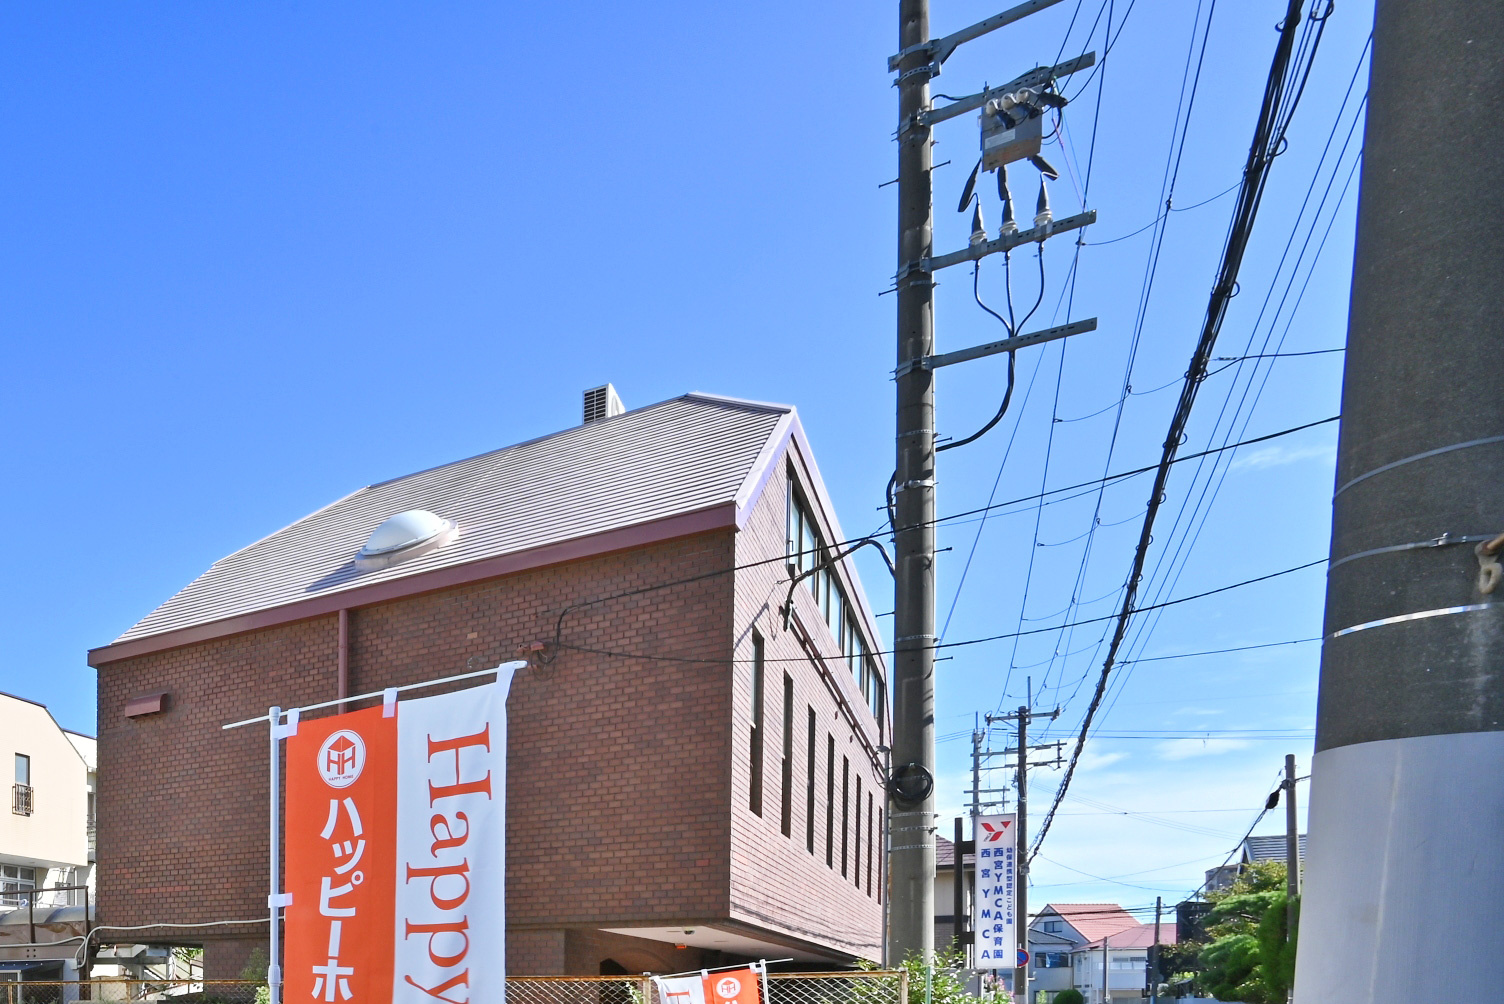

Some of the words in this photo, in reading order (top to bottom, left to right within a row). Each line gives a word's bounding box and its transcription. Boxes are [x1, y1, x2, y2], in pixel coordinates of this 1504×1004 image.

[981, 848, 991, 959] 西宮YMCA
[993, 847, 1004, 959] 西宮YMCA保育園
